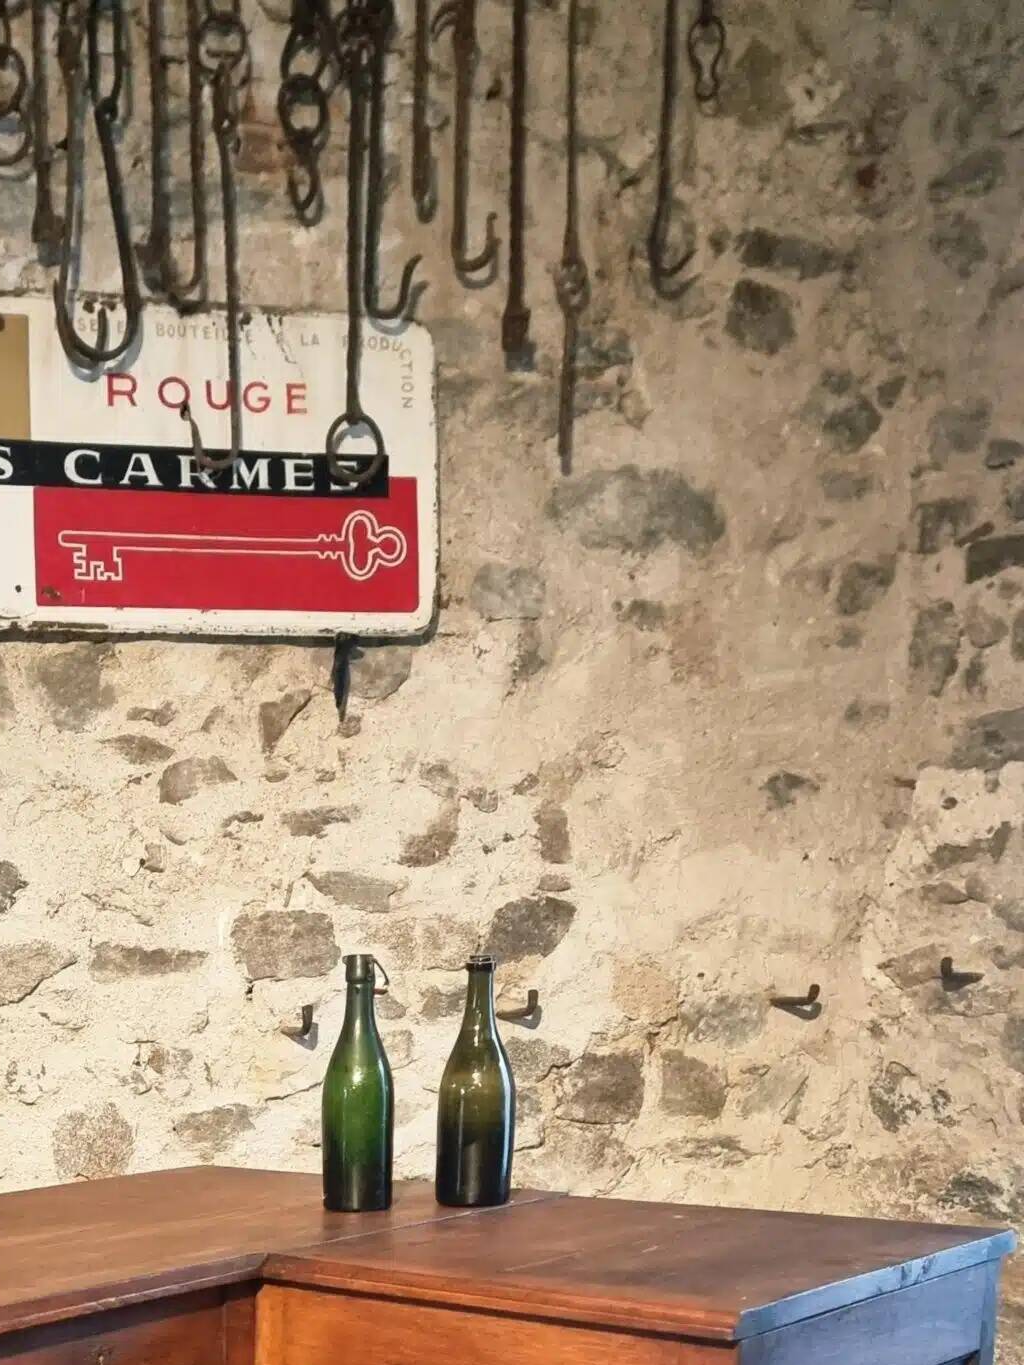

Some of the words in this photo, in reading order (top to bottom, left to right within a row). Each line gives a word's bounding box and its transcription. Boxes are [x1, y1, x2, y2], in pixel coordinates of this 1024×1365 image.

[105, 372, 308, 415] ROUGE
[155, 323, 253, 343] BOUTEILE
[300, 333, 320, 347] LA
[342, 335, 415, 409] PODUCTION
